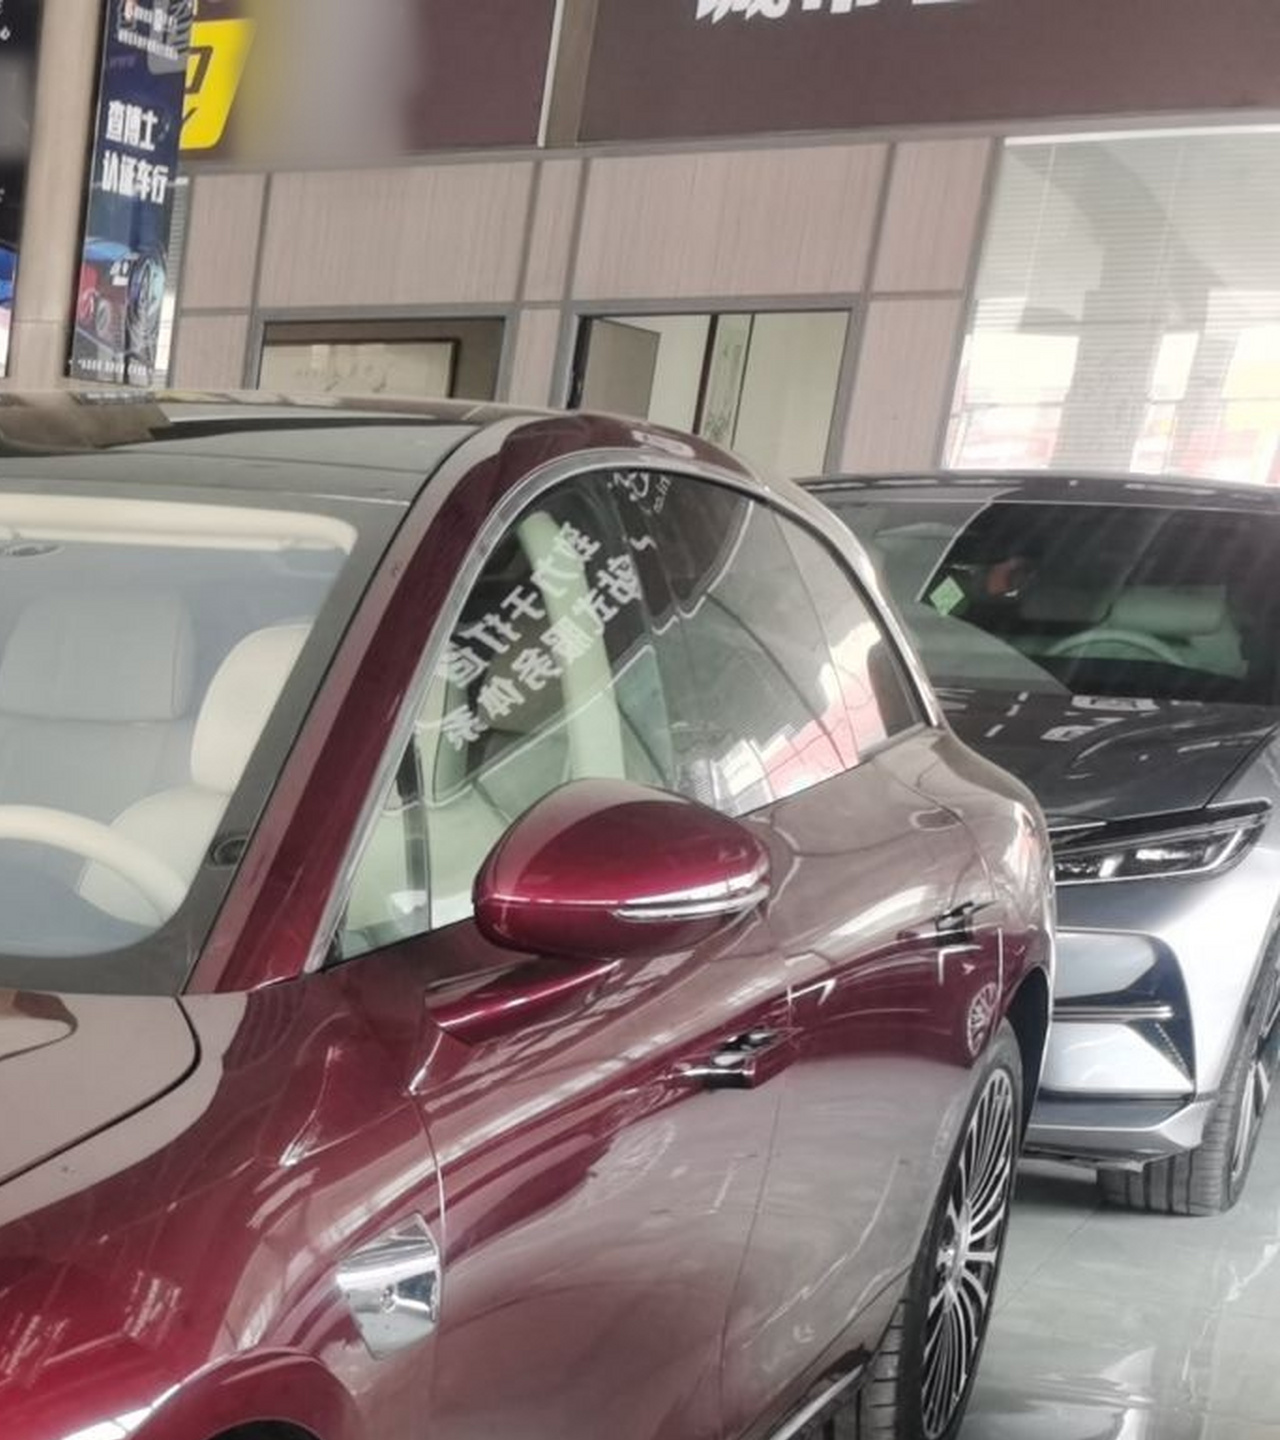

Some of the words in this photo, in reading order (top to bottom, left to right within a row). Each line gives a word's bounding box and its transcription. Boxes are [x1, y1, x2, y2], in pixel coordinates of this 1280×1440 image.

[106, 100, 158, 151] 查博士
[101, 150, 169, 205] 认证车行
